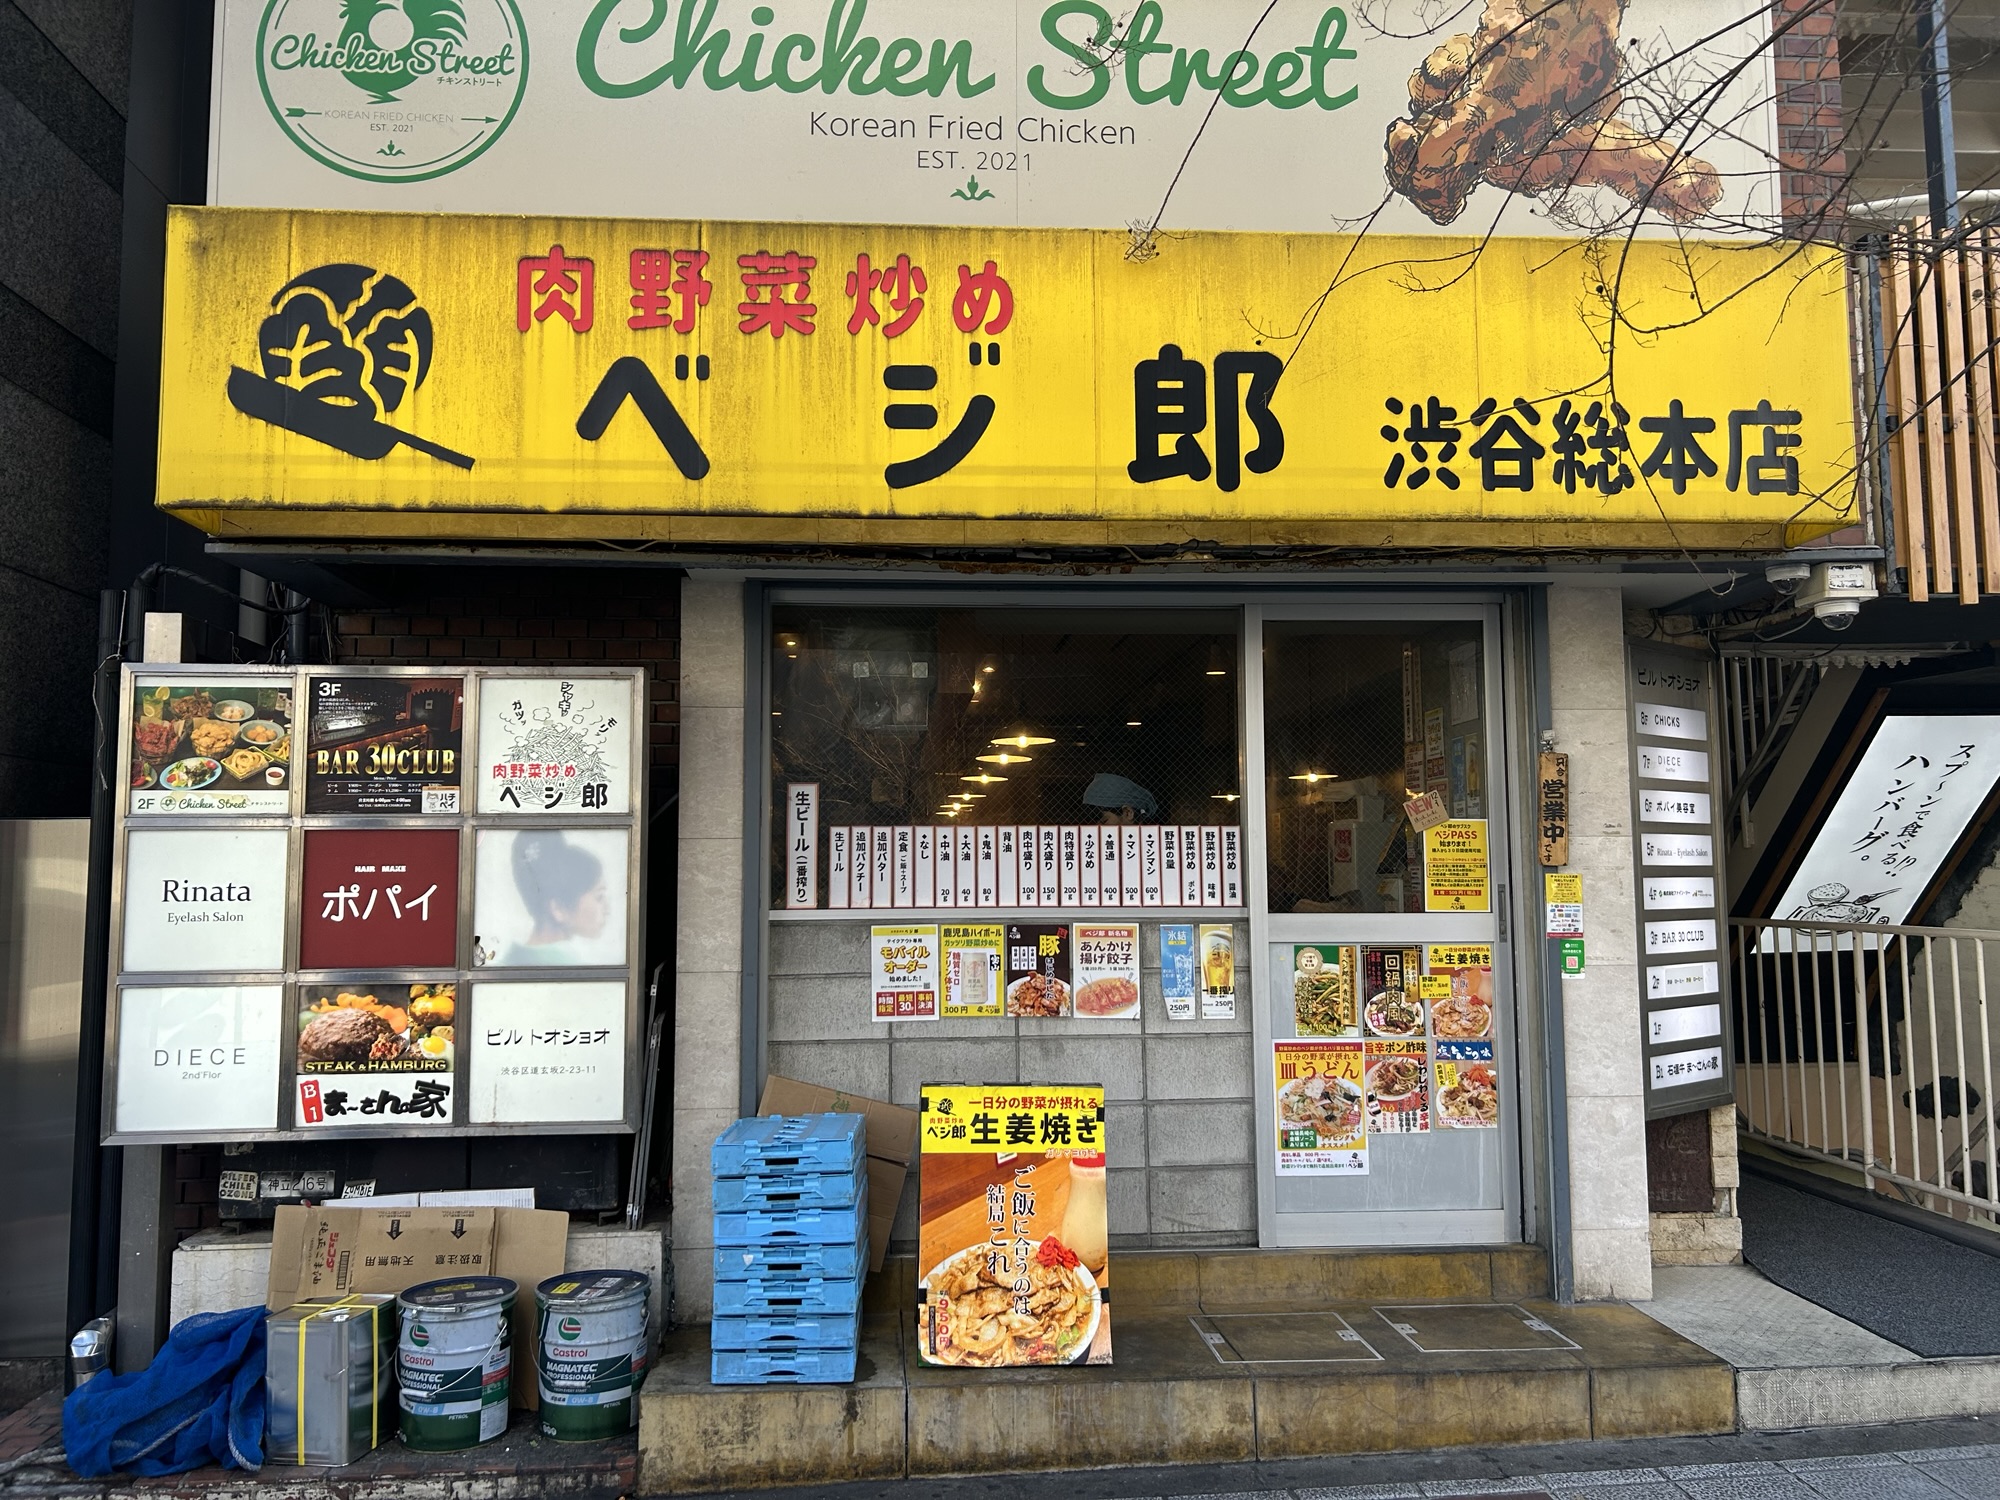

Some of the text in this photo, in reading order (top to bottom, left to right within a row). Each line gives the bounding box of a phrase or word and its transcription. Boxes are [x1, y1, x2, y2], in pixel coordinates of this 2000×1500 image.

[271, 34, 515, 78] Chicken Street
[576, 0, 1358, 110] Chicken Street
[436, 75, 502, 88] チキンストリート
[324, 109, 454, 124] KOREAN FRIED CHICKEN
[370, 122, 414, 134] EST. 2021
[810, 111, 1136, 145] Korean Fried Chicken
[917, 149, 1032, 172] EST. 2021
[516, 244, 1014, 340] 肉野菜炒め
[576, 342, 1284, 493] ベジ郎
[1379, 395, 1803, 497] 渋谷総本店
[318, 682, 342, 697] 3F
[558, 682, 574, 717] シャキッ
[511, 699, 527, 727] ガツッ
[1641, 711, 1681, 728] 8F CHICKS
[315, 749, 360, 775] BAR
[1642, 754, 1681, 769] 7F DIECE
[492, 763, 578, 780] 肉野菜炒め
[137, 798, 247, 810] 2F Chicken Street
[440, 792, 456, 801] ハチ
[499, 781, 608, 810] ベジ郎
[1406, 796, 1433, 817] NEW
[1542, 778, 1566, 843] 営業中
[1644, 798, 1695, 814] 6F ポパイ美容室
[1849, 754, 1930, 862] ハンバーグ。
[898, 831, 909, 852] 定食
[1003, 831, 1012, 853] 背油
[1435, 830, 1478, 840] ベジPASS
[834, 832, 845, 872] 生ビール
[877, 831, 888, 882] 追加バター
[919, 840, 930, 860] なし
[940, 841, 950, 861] 中油
[961, 840, 971, 862] 大油
[981, 840, 992, 861] 鬼油
[1023, 831, 1033, 871] 肉中盛り
[1043, 831, 1054, 871] 肉大盛り
[1064, 831, 1075, 871] 肉特盛り
[1085, 839, 1095, 869] 少なめ
[1105, 840, 1115, 861] 普通
[1126, 840, 1136, 860] マシ
[1145, 839, 1156, 876] マシマシ
[1164, 831, 1175, 870] 野菜の量
[1185, 831, 1196, 870] 野菜炒め
[1226, 831, 1236, 870] 野菜炒め
[1544, 843, 1553, 863] です
[1646, 842, 1709, 859] 5F Rinata Eyelash Salon
[354, 865, 407, 873] HAIR MAKE
[1205, 831, 1216, 899] 野菜炒め 味噌
[161, 879, 252, 903] Rinata
[1649, 886, 1657, 900] 4F
[321, 883, 438, 922] ポパイ
[167, 910, 245, 926] Eyelash Salon
[943, 928, 1002, 938] 鹿児島ハイボール
[1168, 930, 1187, 941] 氷結
[1650, 930, 1705, 945] 3F BAR 30 CLUB
[944, 938, 1000, 947] ガッツリ野菜炒めに
[1038, 934, 1061, 957] 豚
[1080, 941, 1133, 952] あんかけ
[880, 945, 931, 960] モバイル
[1079, 952, 1133, 965] 揚げ餃子
[1444, 953, 1490, 965] 生姜焼き
[884, 960, 928, 974] オーダー
[952, 951, 961, 986] 糖質ゼロ
[889, 975, 922, 983] 始めました！
[944, 951, 953, 1001] プリン体ゼロ
[1045, 956, 1055, 1000] はじめました
[1652, 975, 1660, 990] 2F
[1385, 954, 1402, 1022] 回鍋肉風
[878, 996, 894, 1004] 時間
[898, 993, 913, 1002] 最短
[917, 993, 933, 1002] 事前
[918, 1001, 933, 1009] 決済
[1169, 1003, 1190, 1011] 250円
[1653, 1021, 1661, 1035] 1F
[1364, 1041, 1427, 1053] 旨辛ポン酢味
[1436, 1044, 1492, 1060] 塩とんこつ味
[153, 1047, 247, 1067] DIECE
[304, 1060, 446, 1072] STEAK & HAMBURG
[500, 1065, 597, 1076] 渋谷区道玄坂2-23-11
[1279, 1060, 1360, 1080] 皿うどん
[1655, 1064, 1663, 1079] B1
[1667, 1063, 1685, 1075] 石垣牛
[968, 1096, 1098, 1110] 一日分の野菜が摂れる
[929, 1117, 964, 1125] 肉野菜炒め
[970, 1112, 1098, 1145] 生姜焼き
[927, 1124, 967, 1140] ベジ郎
[222, 1182, 252, 1190] CHILE
[268, 1176, 328, 1191] 神立216号
[344, 1184, 373, 1197] ZOMBIE
[986, 1184, 1010, 1275] 結局これ
[1012, 1165, 1036, 1315] ご飯に合うのは
[365, 1255, 414, 1267] 天地無用
[435, 1254, 482, 1265] 取扱注意
[939, 1298, 949, 1350] 950円
[404, 1353, 435, 1367] Castrol
[552, 1347, 588, 1358] Castrol
[546, 1361, 598, 1373] MAGNATEC
[547, 1372, 595, 1381] PROFESSIONAL
